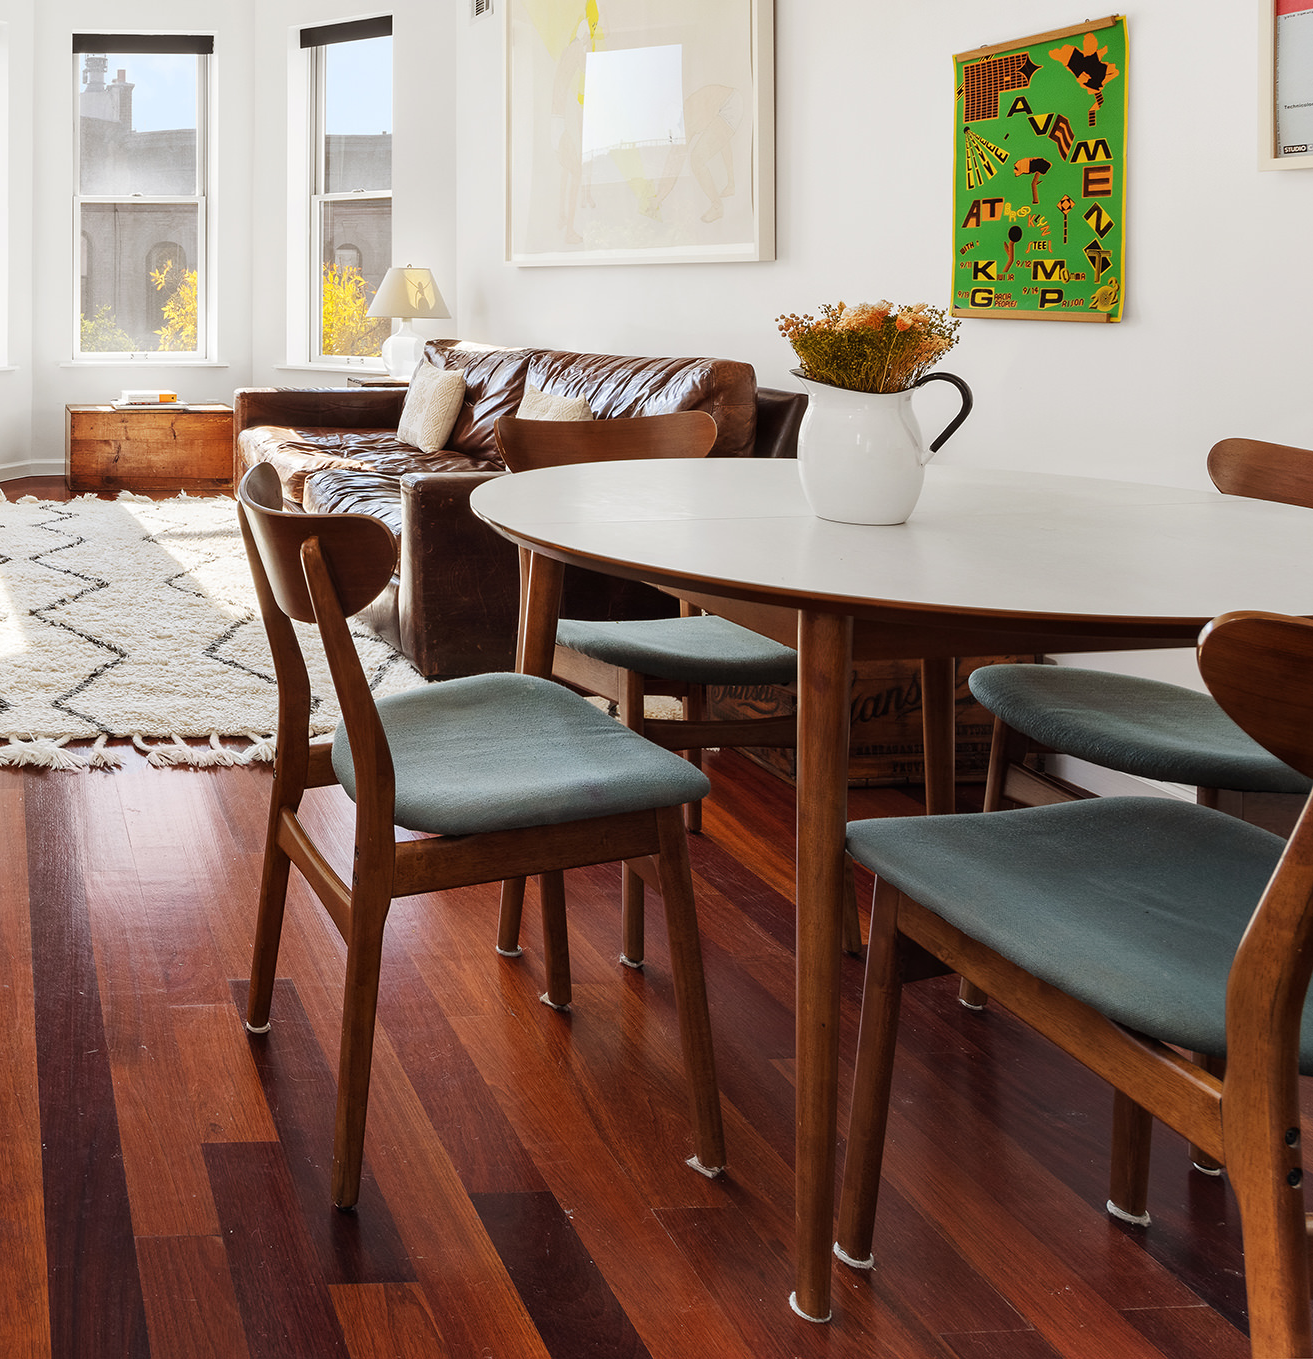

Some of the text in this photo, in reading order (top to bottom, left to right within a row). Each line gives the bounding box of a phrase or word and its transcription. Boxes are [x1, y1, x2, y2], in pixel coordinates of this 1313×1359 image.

[1284, 145, 1307, 153] STUDIO
[961, 197, 1005, 228] AT
[1025, 240, 1053, 254] STEEL
[1015, 259, 1032, 268] 9/12
